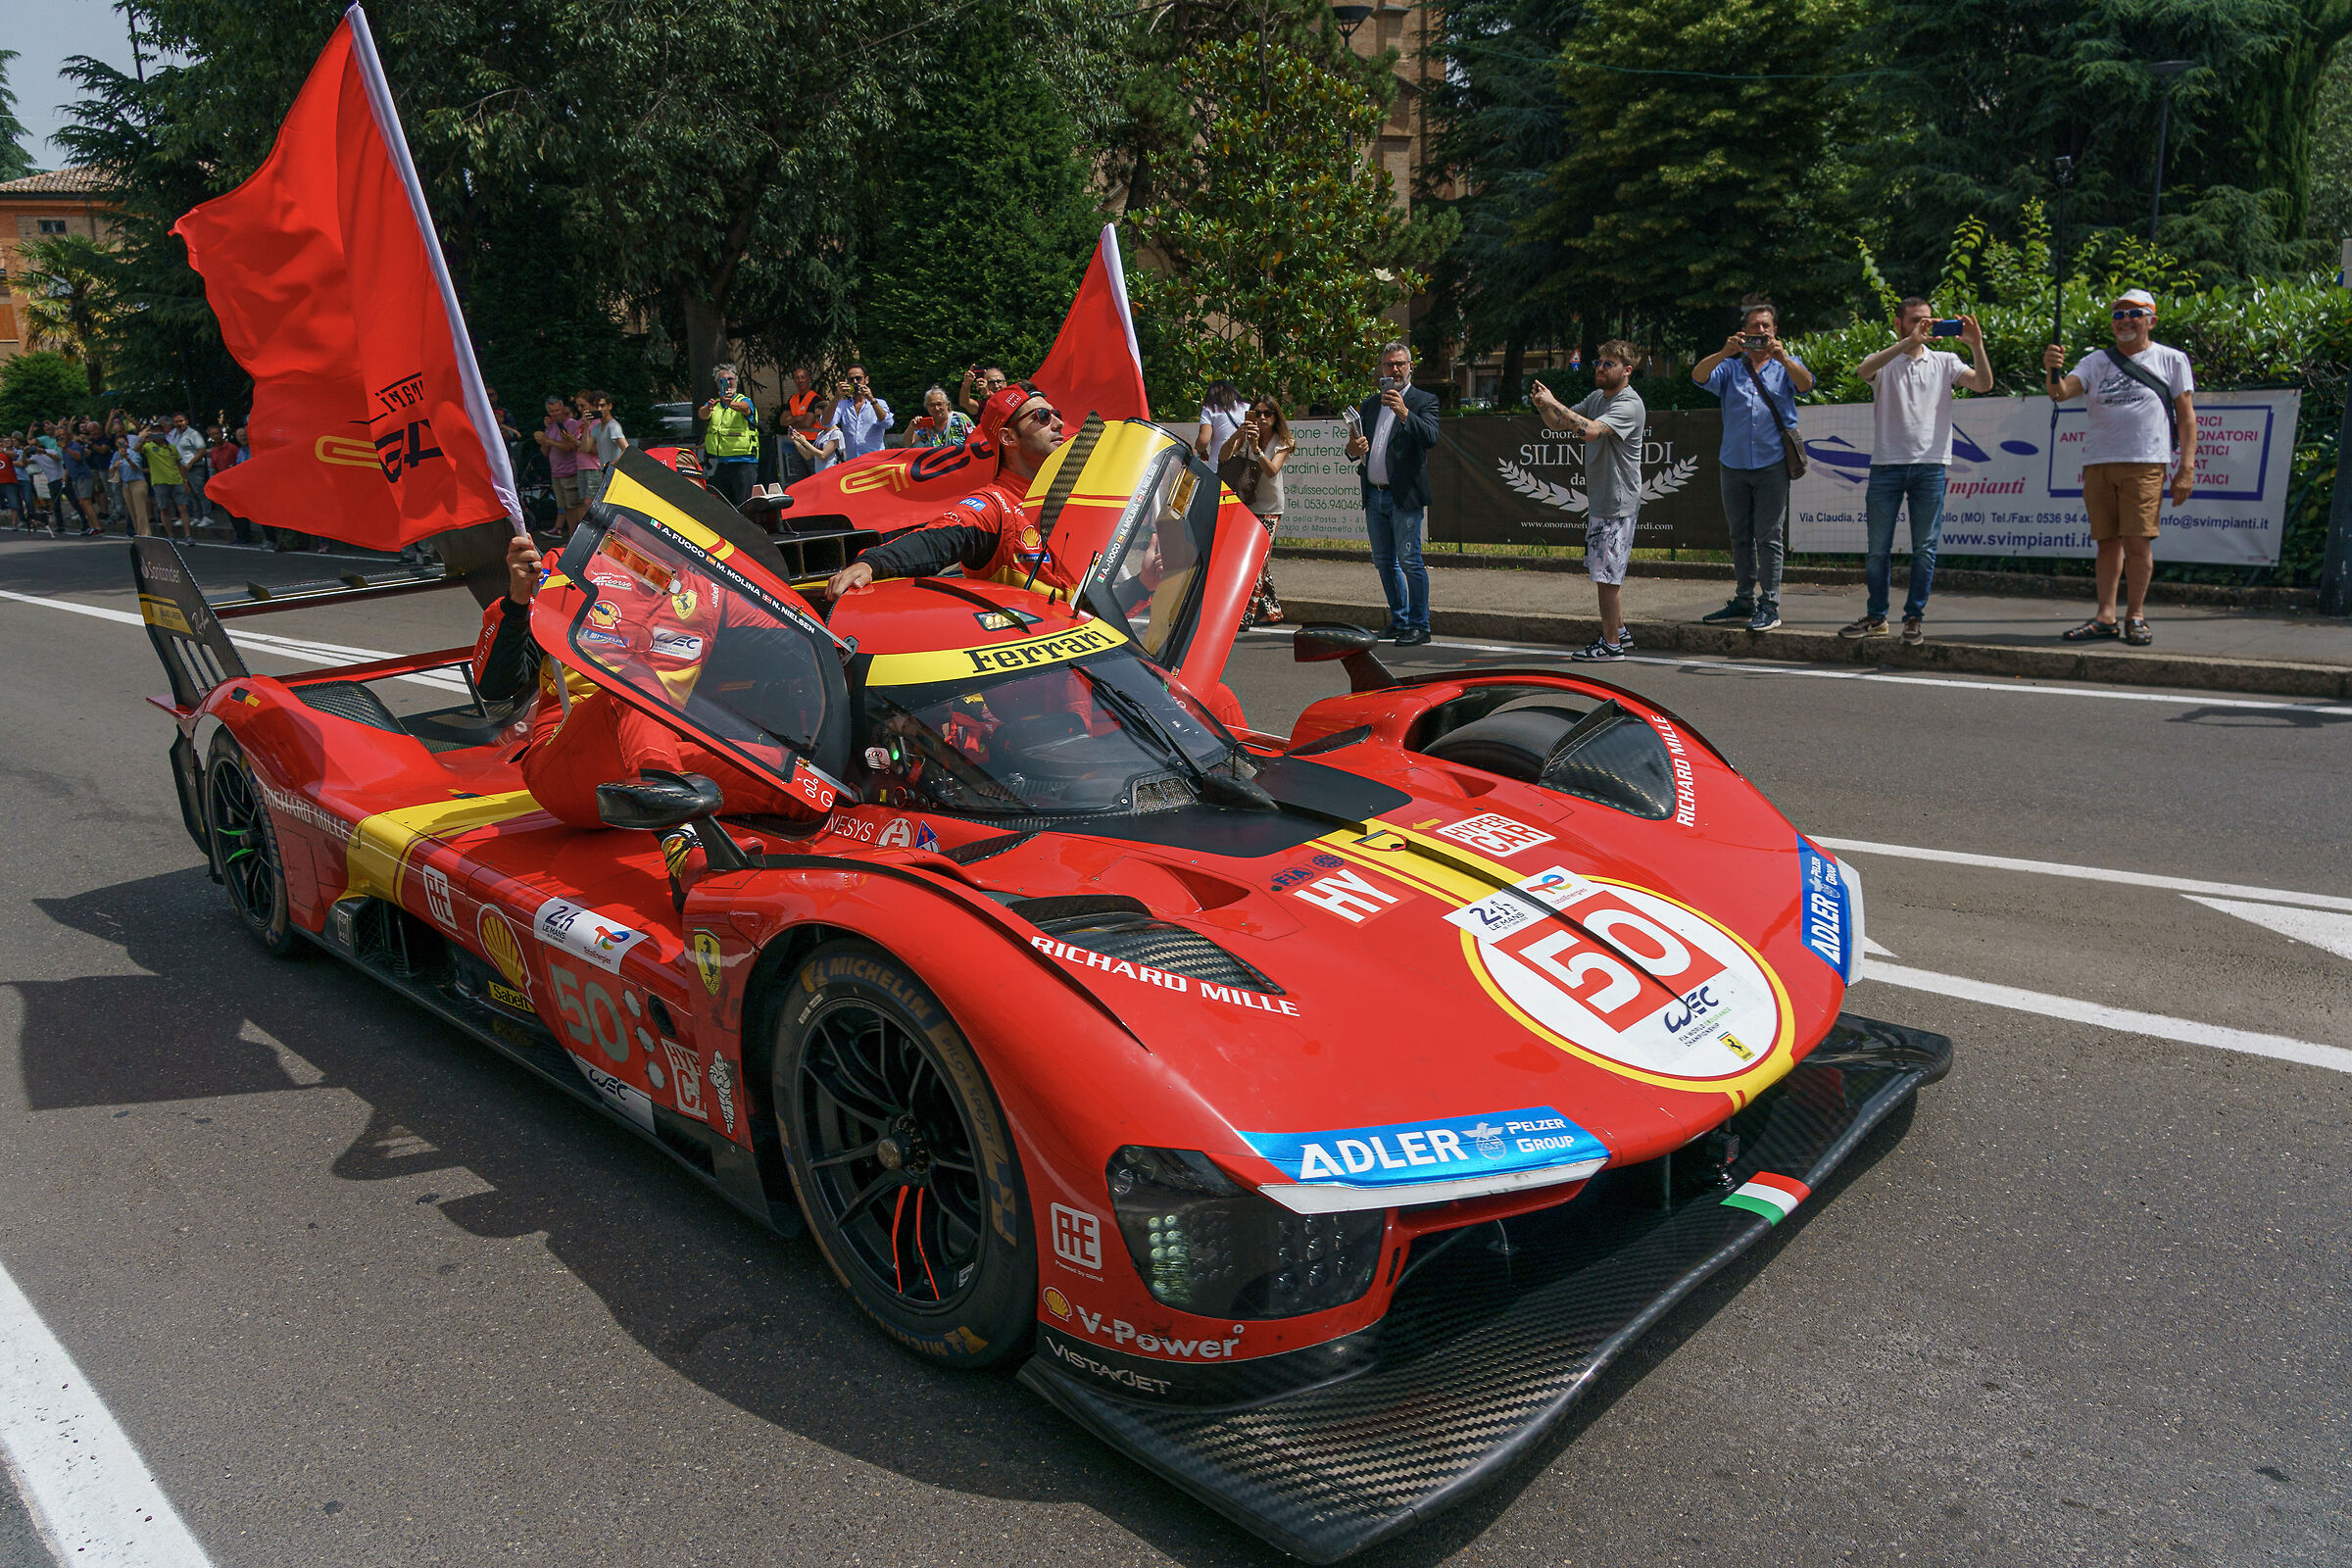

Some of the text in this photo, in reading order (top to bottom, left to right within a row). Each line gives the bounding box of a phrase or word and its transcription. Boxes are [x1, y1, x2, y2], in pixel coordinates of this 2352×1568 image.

[2060, 431, 2087, 442] ANT
[1322, 465, 1331, 474] e
[1945, 477, 2026, 499] Impianti
[1799, 513, 1814, 522] Via
[1816, 513, 1855, 524] Claudia,
[1960, 512, 1985, 524] (MO)
[1990, 512, 2034, 524] Tel./Fax:
[2036, 513, 2061, 524] 0536
[2064, 514, 2078, 524] 94
[672, 532, 706, 559] FUOCO
[1942, 532, 2093, 549] www.svimpianti.it
[726, 568, 761, 598] MOLINA
[780, 605, 815, 634] NIELSEN
[963, 628, 1116, 673] Ferrari
[1650, 714, 1695, 827] RICHARD MILLE
[262, 785, 350, 842] RICHARD MILLE
[823, 812, 874, 842] NESYS
[1444, 815, 1513, 840] HYPER
[1470, 824, 1548, 854] CAR
[1293, 869, 1399, 923] HY
[549, 927, 566, 940] MANS
[1500, 910, 1526, 927] MANS
[1811, 893, 1840, 965] ADLER
[1518, 909, 1691, 1013] 50
[829, 956, 933, 1020] MICHELIN
[1030, 936, 1300, 1017] RICHARD MILLE
[550, 962, 630, 1063] 50
[1664, 986, 1720, 1034] WEC
[589, 1069, 630, 1101] WEC
[1505, 1117, 1567, 1134] PELZER
[1299, 1129, 1469, 1180] ADLER
[1516, 1135, 1575, 1152] GROUP
[1076, 1304, 1240, 1358] V-Power
